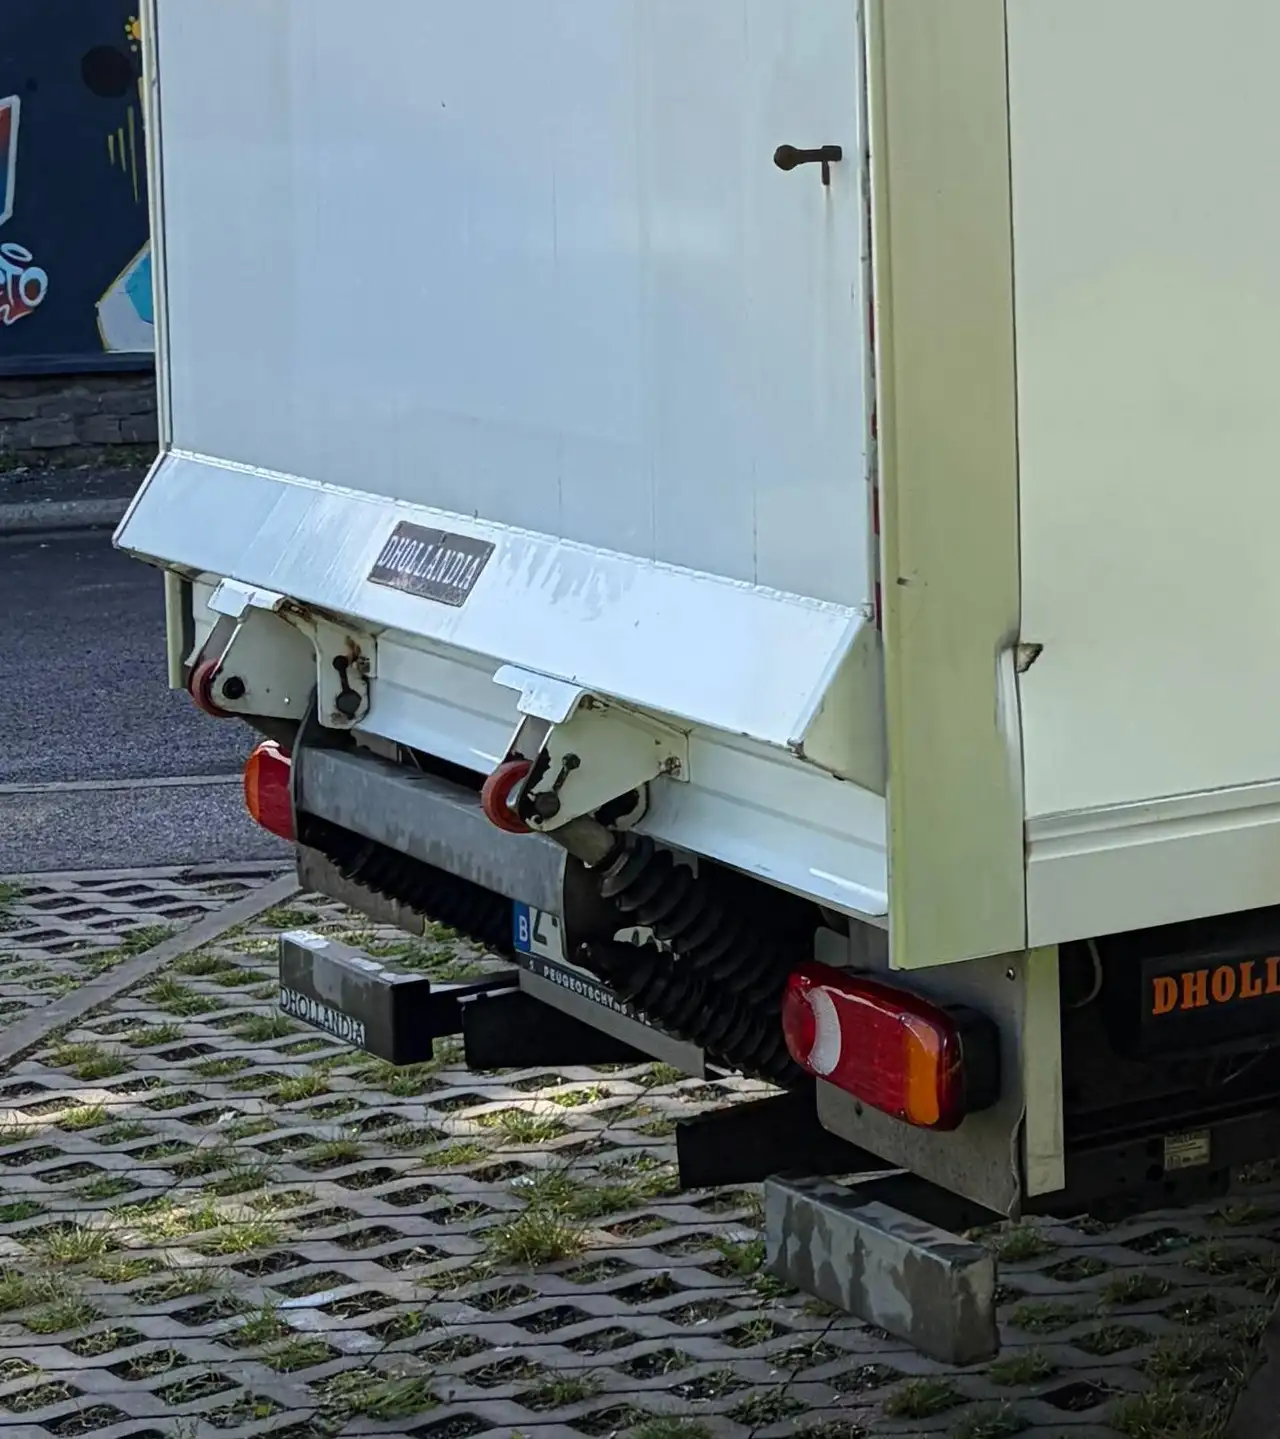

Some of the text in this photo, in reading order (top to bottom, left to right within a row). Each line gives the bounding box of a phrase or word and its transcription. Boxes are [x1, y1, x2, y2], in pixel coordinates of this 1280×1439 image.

[377, 535, 482, 591] DHOLLANDIA
[518, 914, 529, 942] B
[280, 987, 367, 1048] DHOLLANDIA
